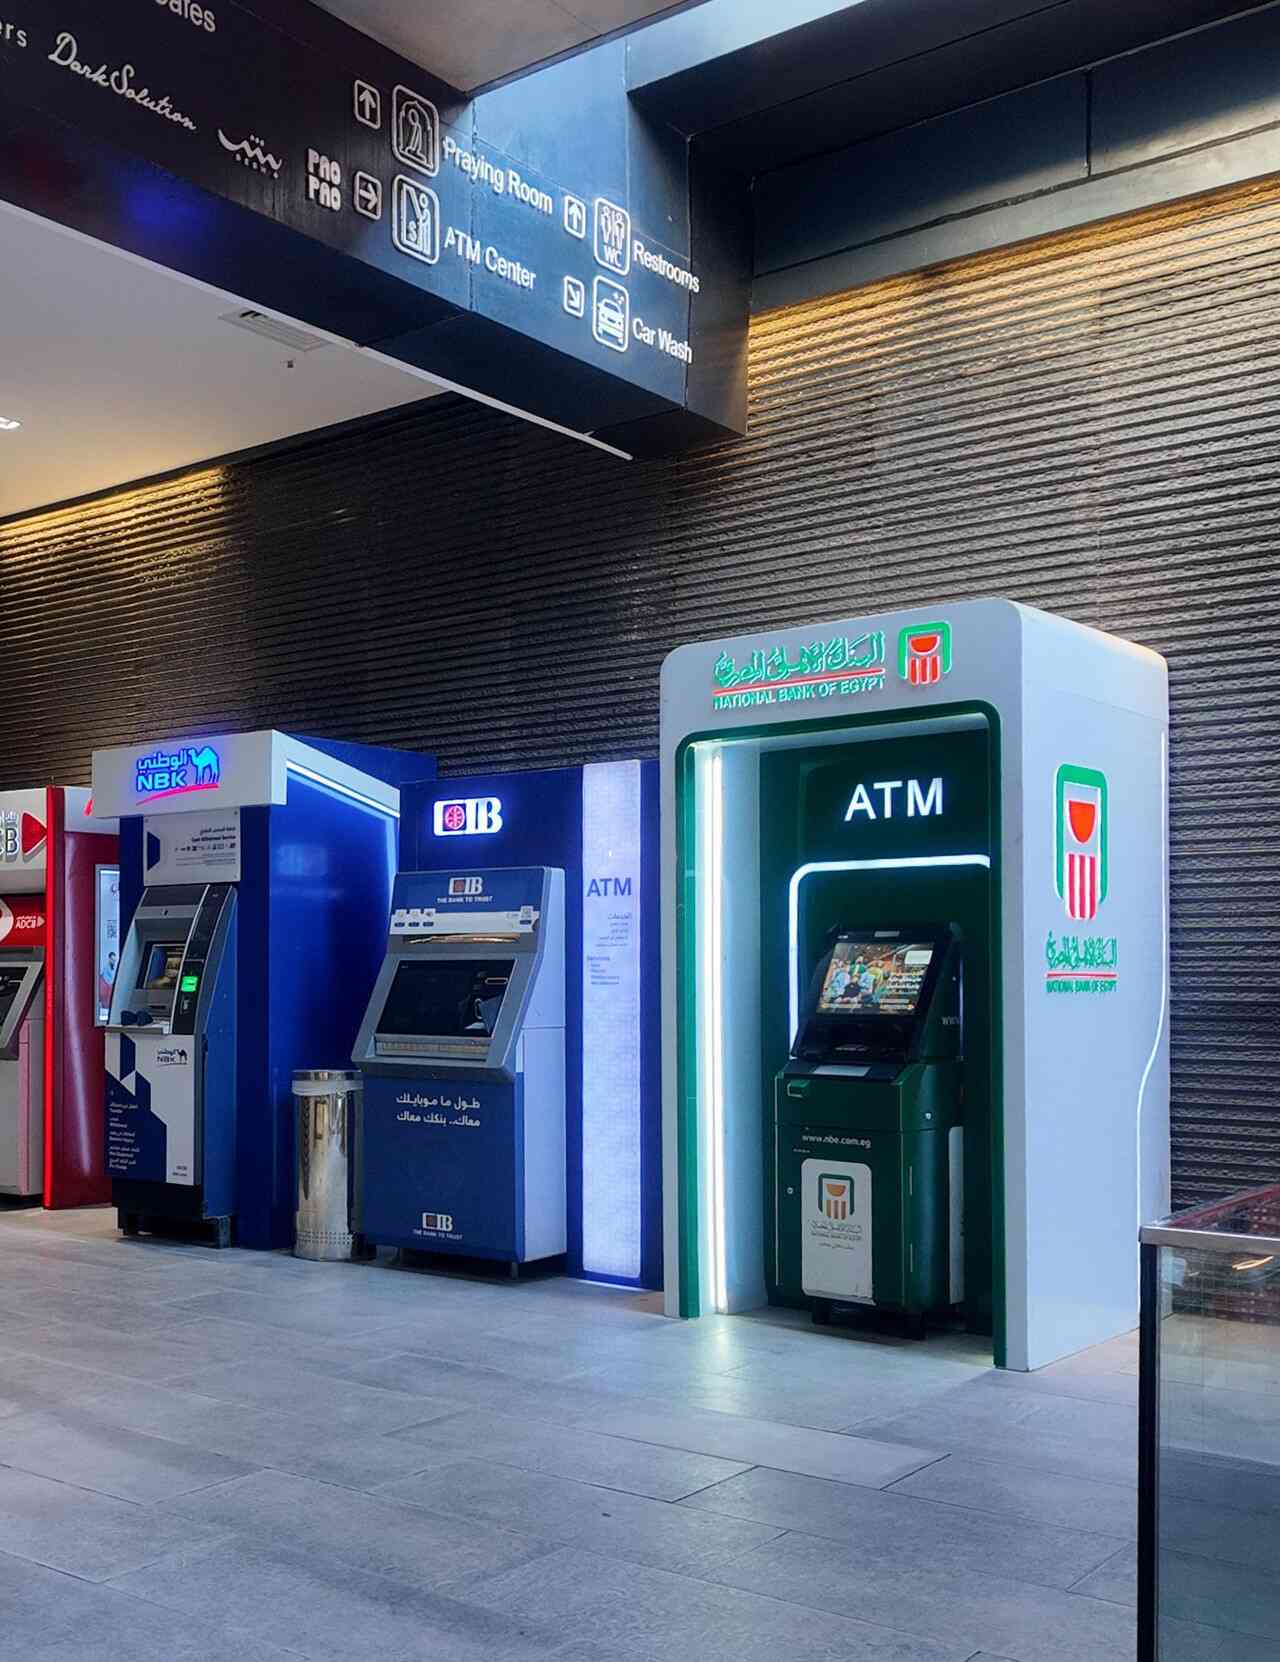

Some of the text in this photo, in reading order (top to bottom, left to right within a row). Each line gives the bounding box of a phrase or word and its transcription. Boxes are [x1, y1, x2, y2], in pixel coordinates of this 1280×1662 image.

[443, 136, 553, 214] Praying Room
[444, 226, 537, 289] ATM Center
[604, 246, 622, 267] WC
[633, 240, 700, 293] Restrooms
[633, 318, 693, 364] Car Wash
[714, 676, 886, 710] NATIONAL BANK OF EGYPT
[138, 749, 187, 774] الوطني
[137, 770, 188, 791] NBK
[433, 797, 503, 836] CIB
[844, 777, 943, 822] ATM
[587, 877, 632, 896] ATM
[440, 1096, 451, 1106] ما
